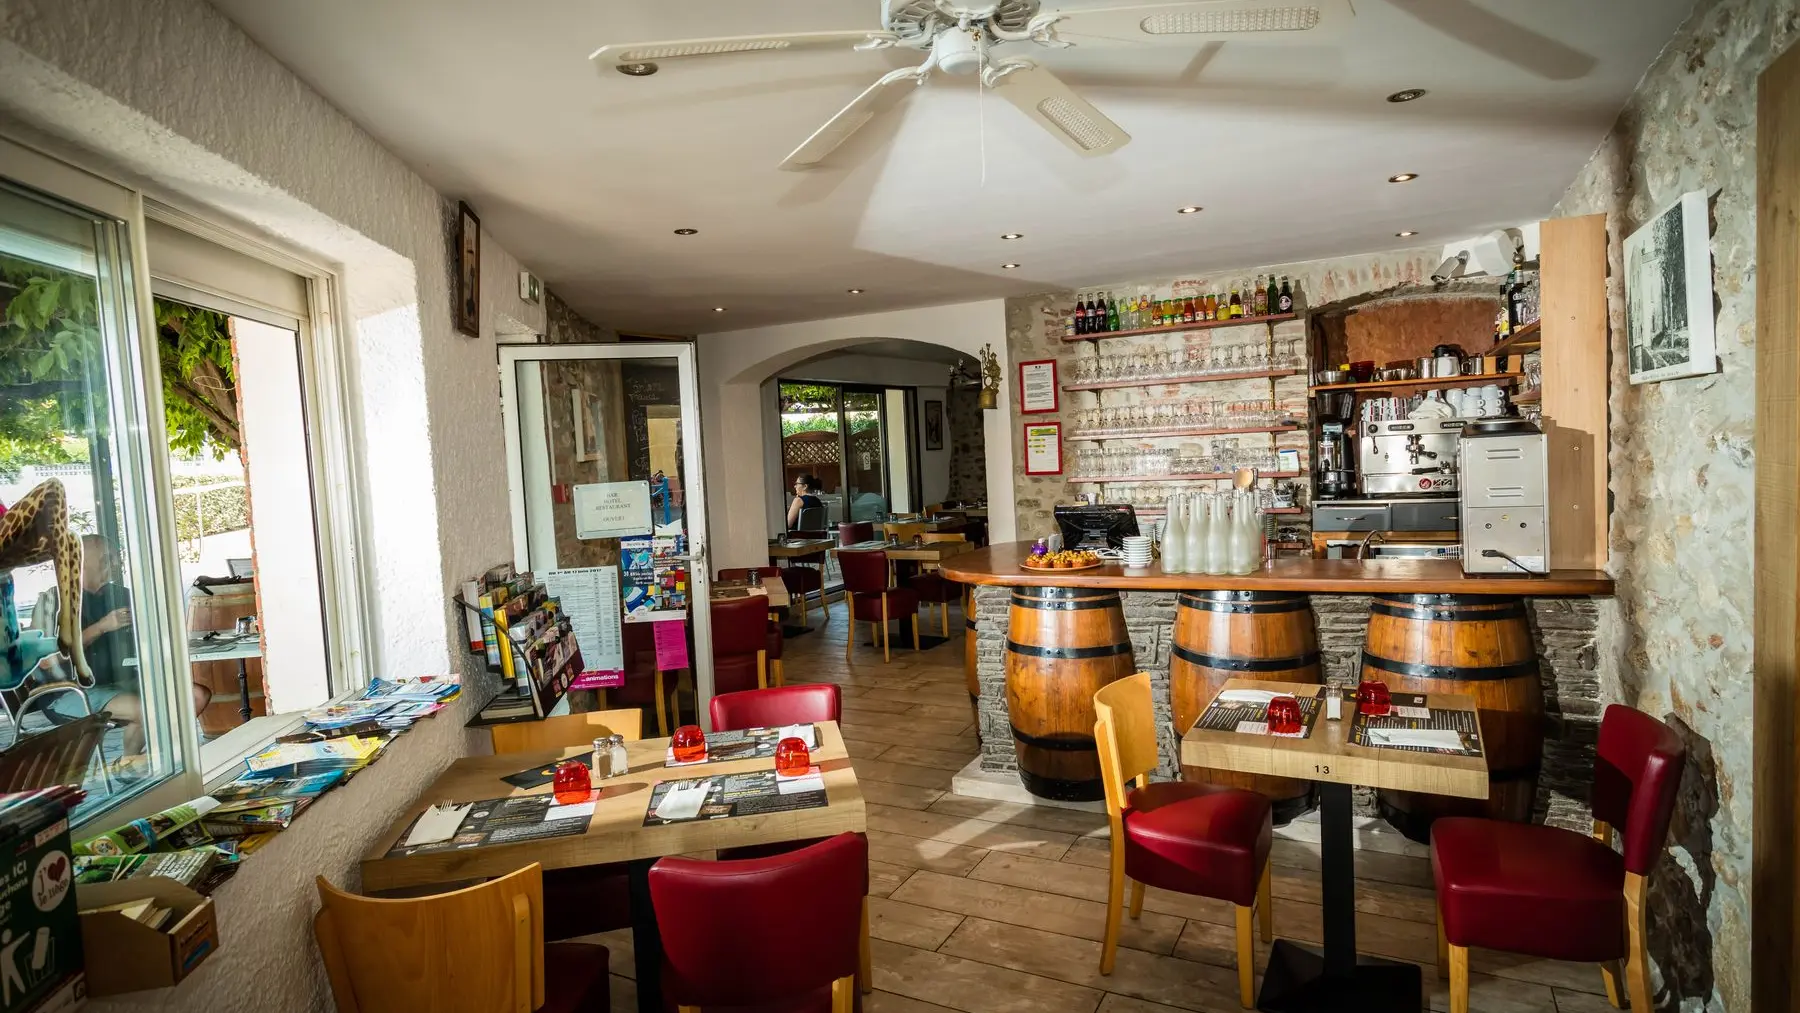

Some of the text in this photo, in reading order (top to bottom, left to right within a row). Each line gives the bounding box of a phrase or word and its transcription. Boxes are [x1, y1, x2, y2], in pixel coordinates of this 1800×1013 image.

[585, 674, 619, 682] animations
[1315, 765, 1330, 774] 13
[12, 860, 27, 877] ICI
